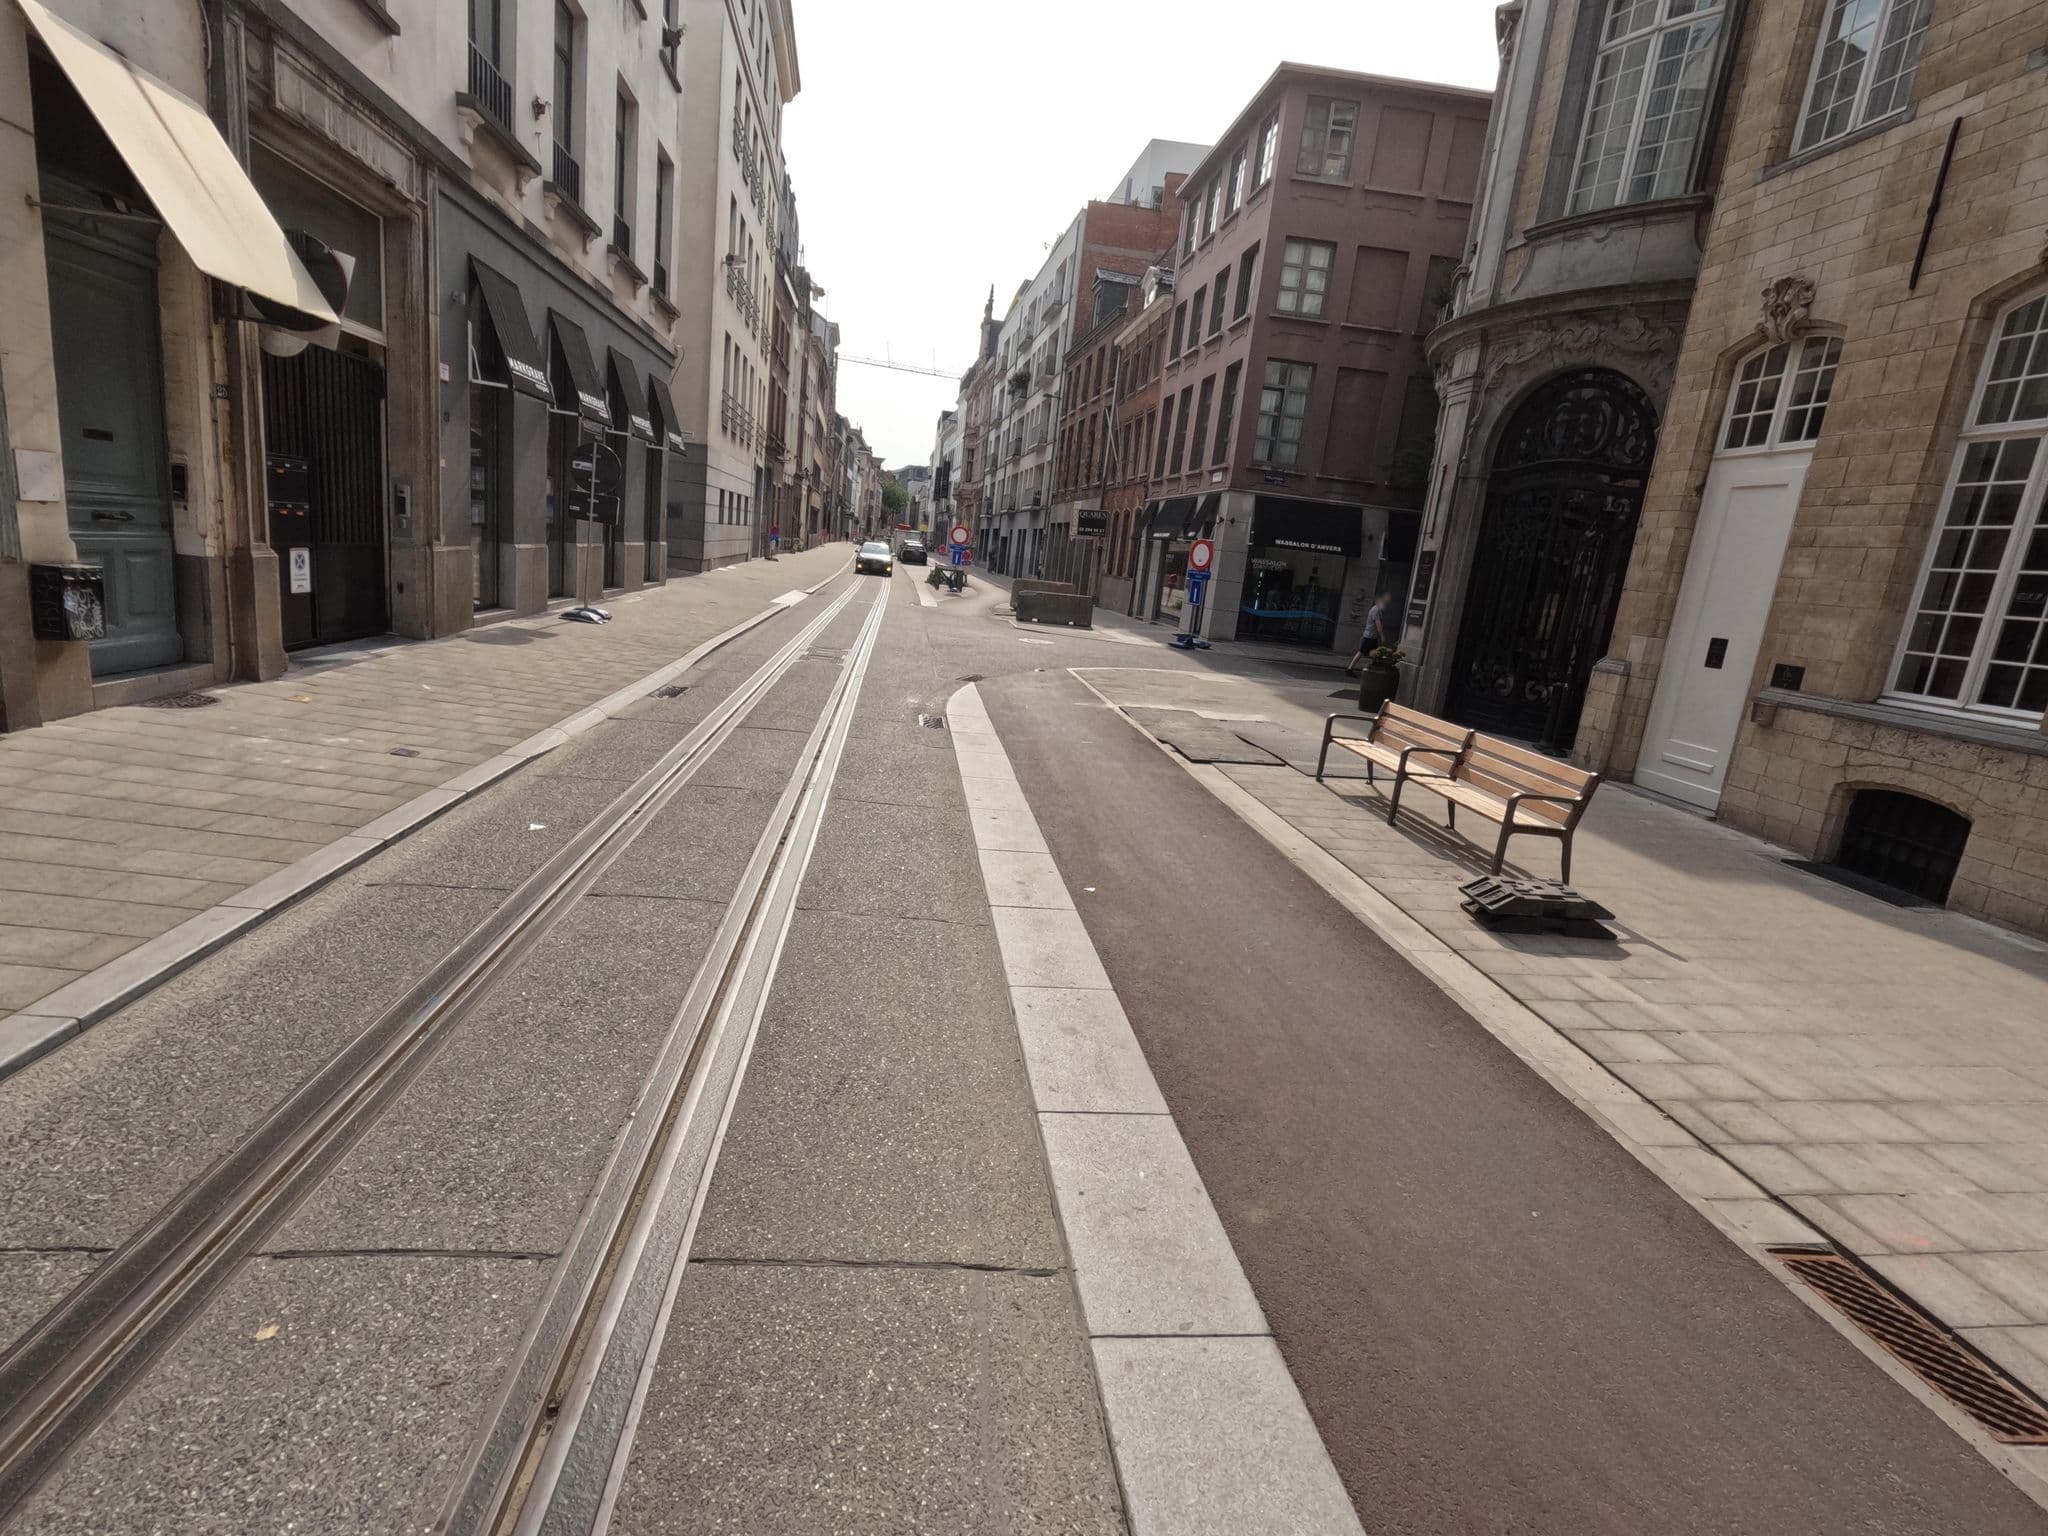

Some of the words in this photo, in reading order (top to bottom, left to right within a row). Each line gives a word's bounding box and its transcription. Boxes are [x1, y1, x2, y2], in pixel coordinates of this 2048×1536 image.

[507, 356, 547, 384] MARKGRAVE
[1275, 539, 1310, 549] WASSALON
[1310, 543, 1342, 552] D'ANVERS
